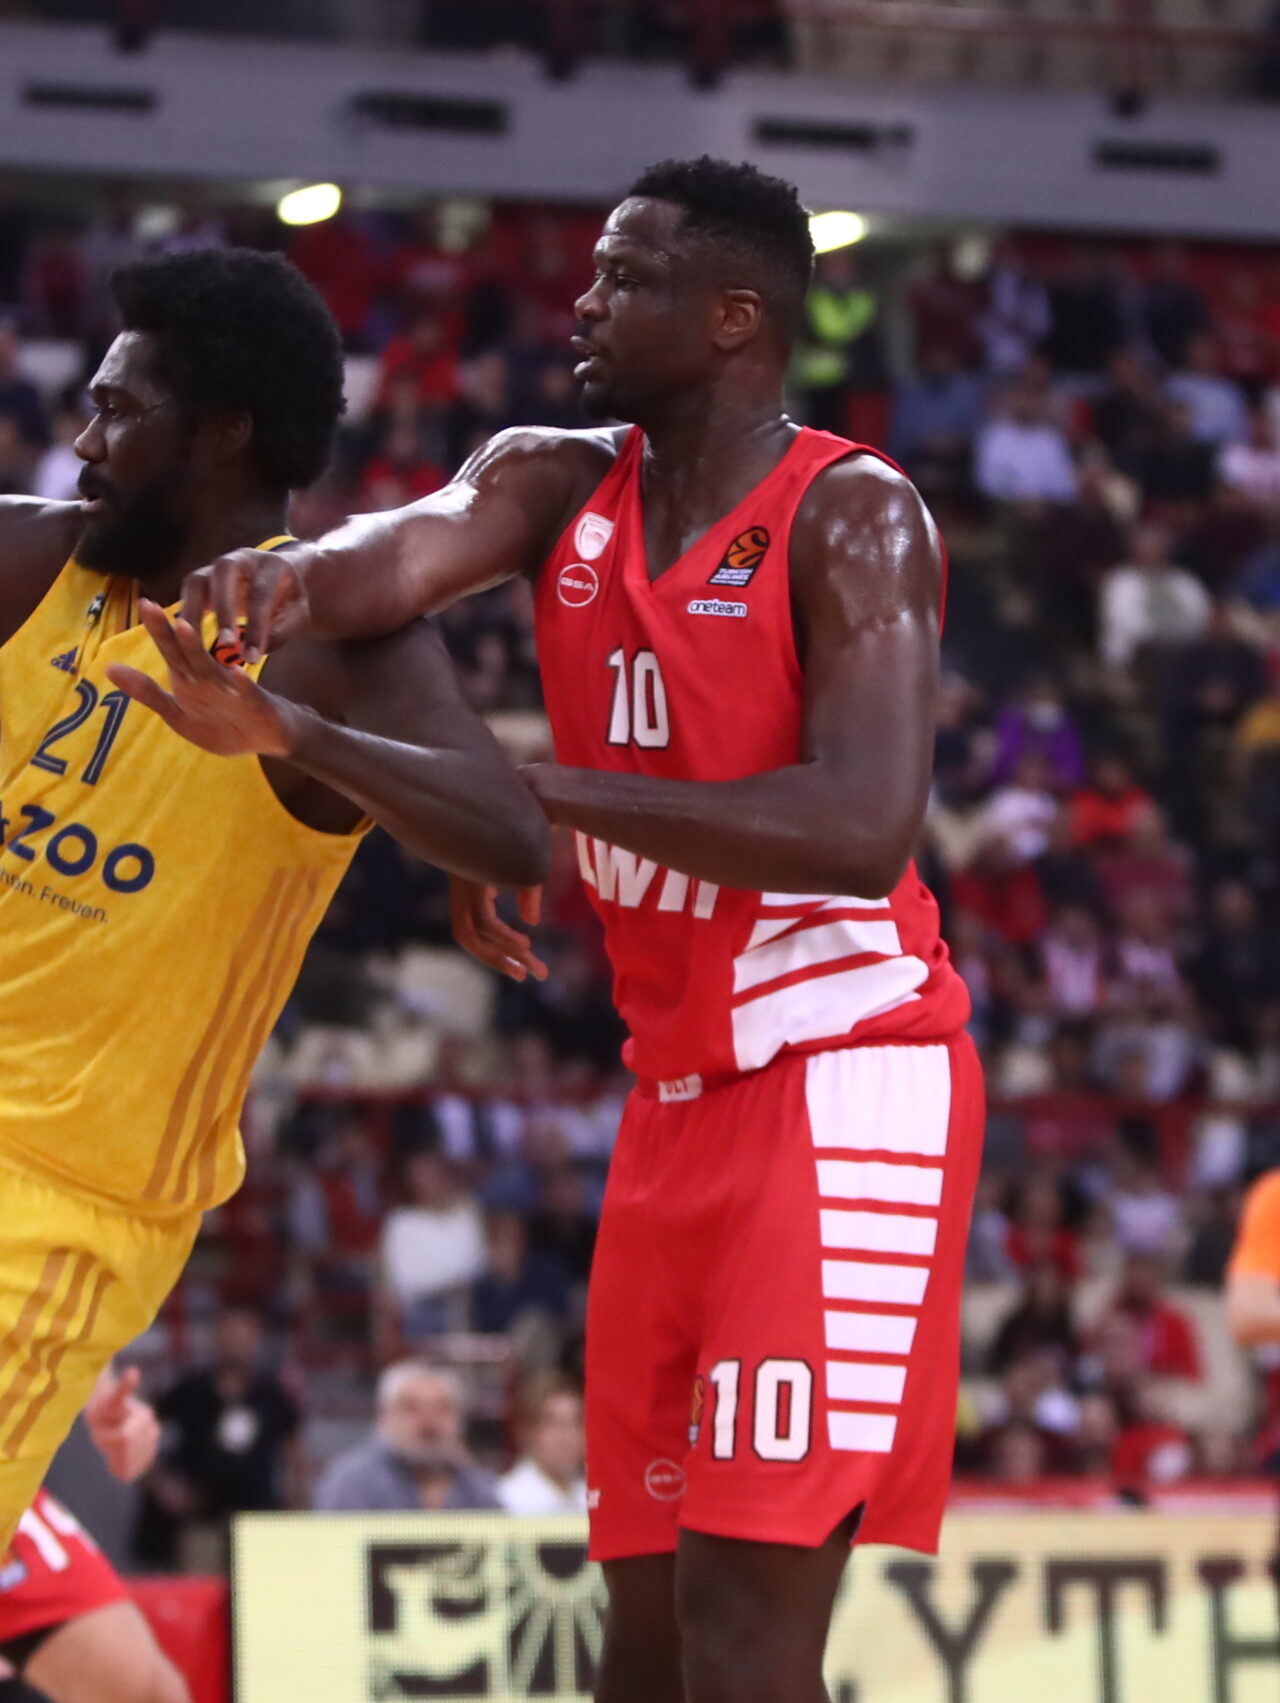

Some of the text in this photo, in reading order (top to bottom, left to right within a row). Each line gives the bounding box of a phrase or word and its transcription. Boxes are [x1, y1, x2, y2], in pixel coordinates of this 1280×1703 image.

[689, 602, 746, 615] oneteam
[30, 678, 131, 786] 21
[605, 643, 670, 748] 10
[708, 1357, 814, 1462] 10
